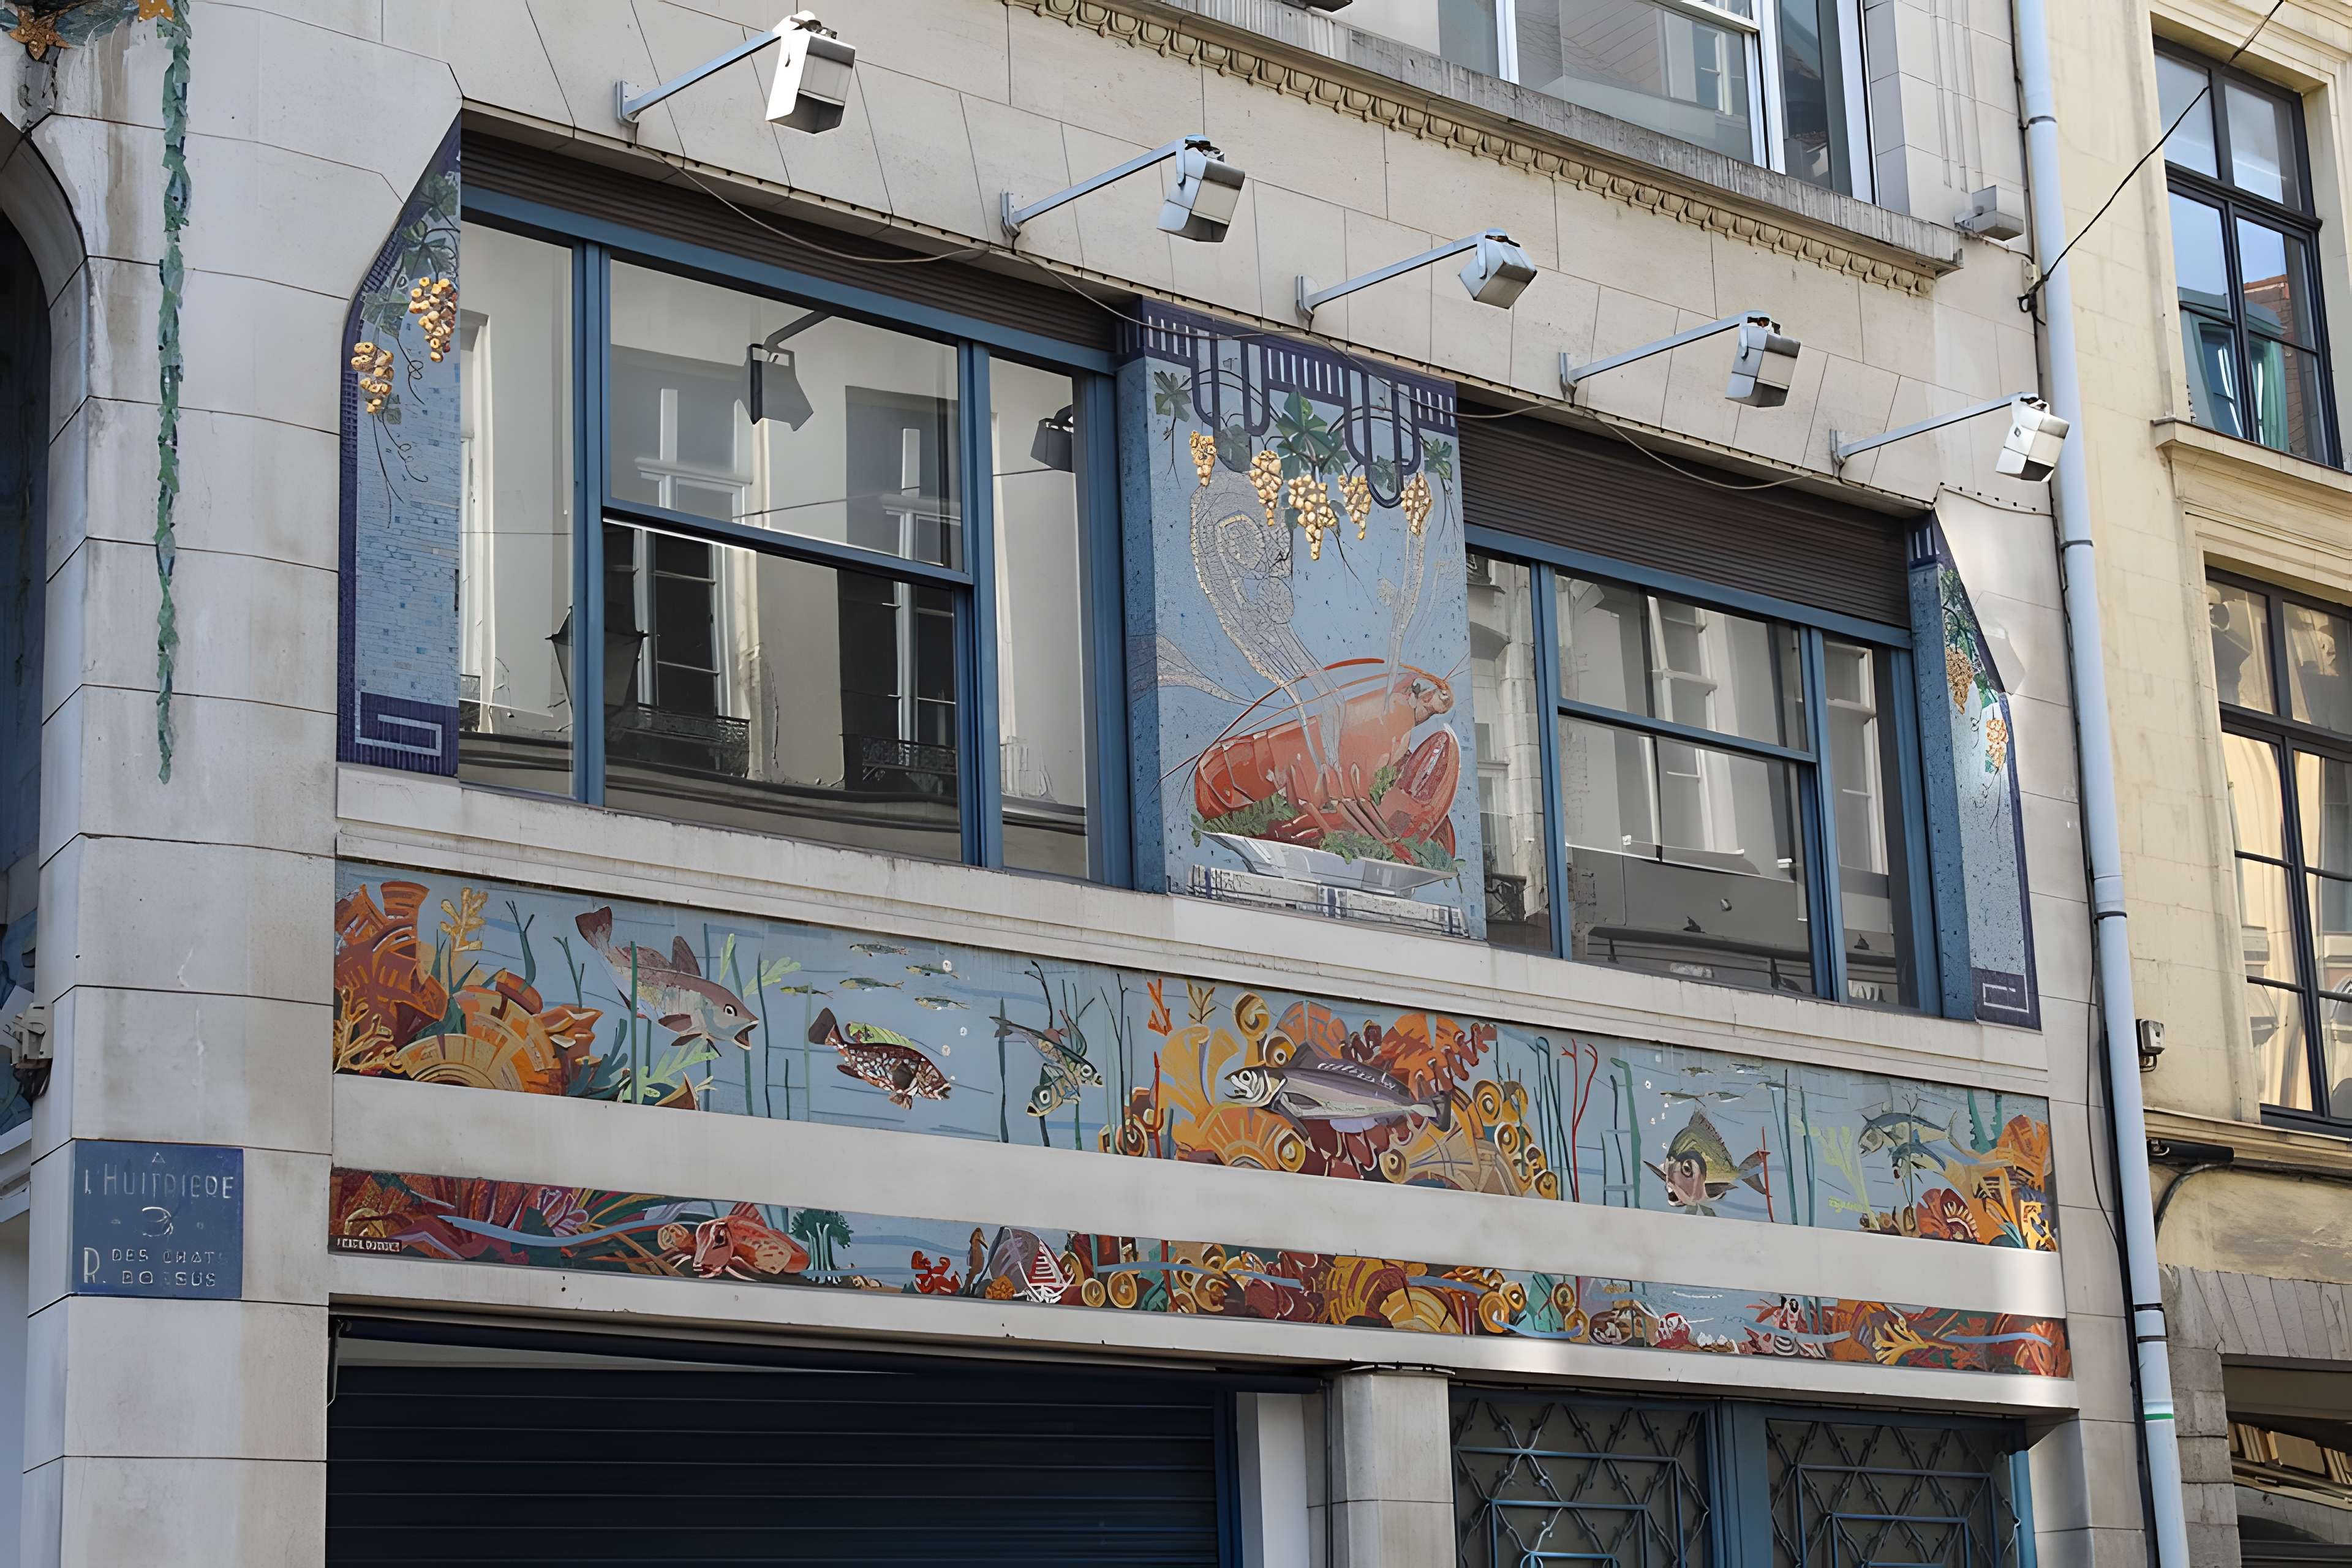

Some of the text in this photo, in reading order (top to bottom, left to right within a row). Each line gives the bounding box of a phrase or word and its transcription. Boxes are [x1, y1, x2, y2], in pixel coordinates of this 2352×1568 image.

[111, 1249, 149, 1262] DES
[163, 1250, 228, 1264] CHAT
[122, 1270, 216, 1287] BOSUS
